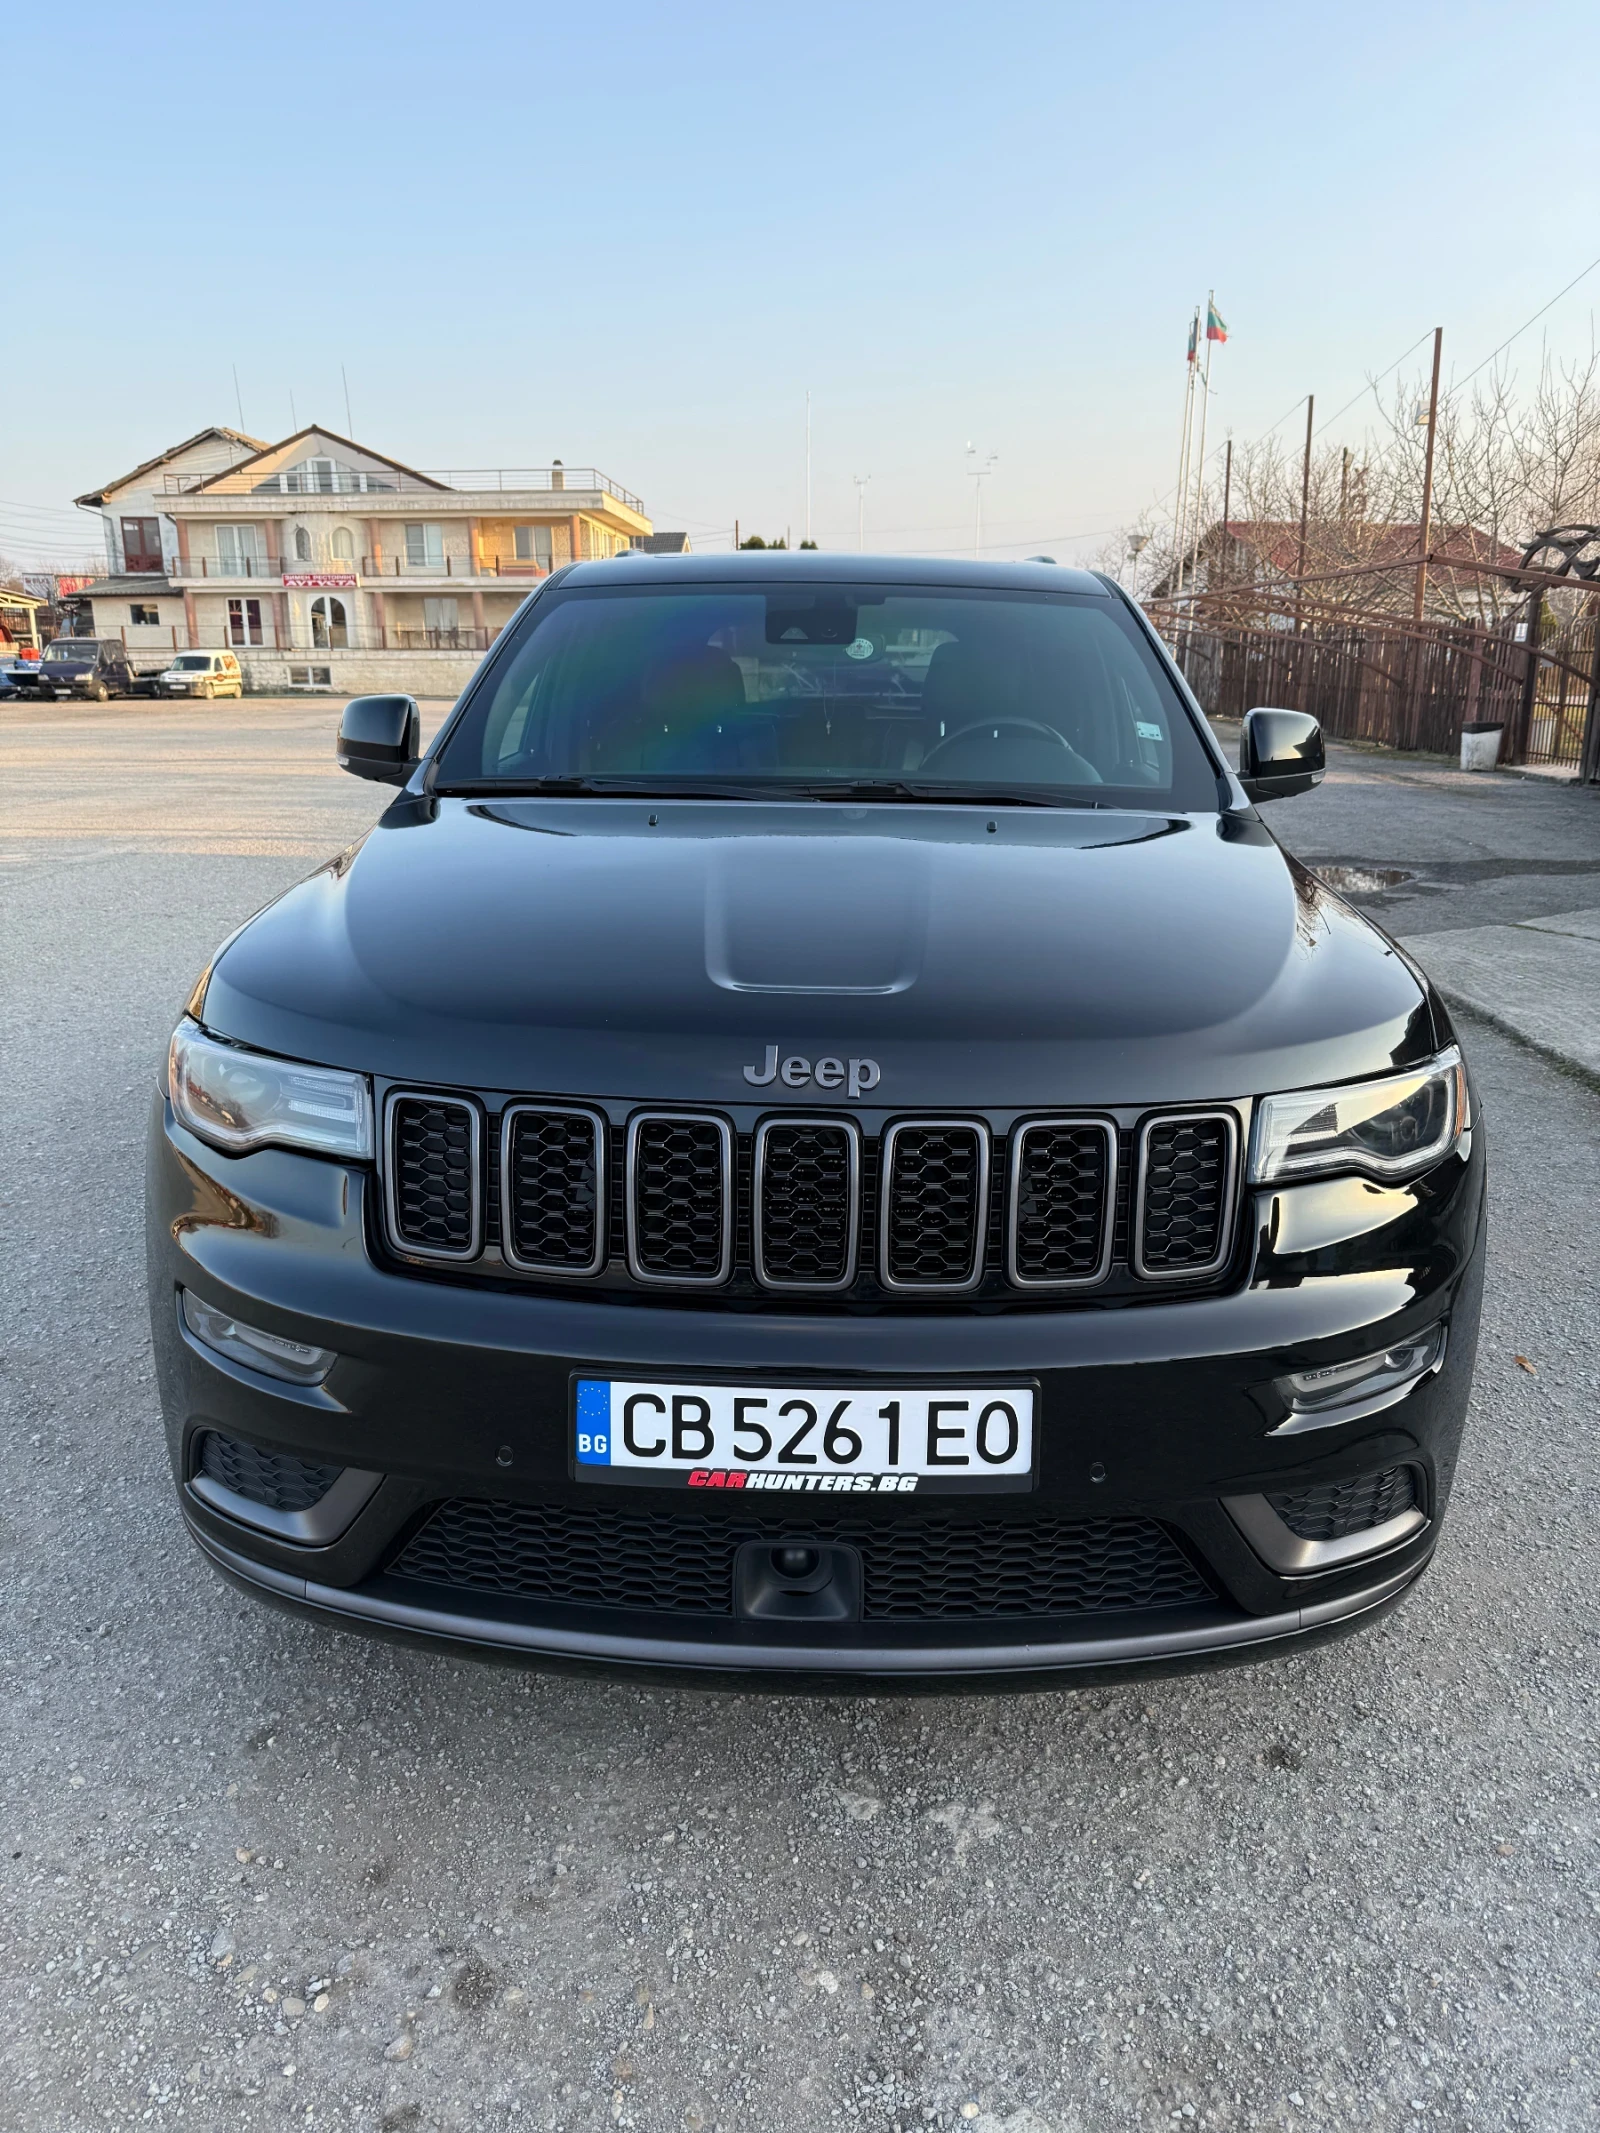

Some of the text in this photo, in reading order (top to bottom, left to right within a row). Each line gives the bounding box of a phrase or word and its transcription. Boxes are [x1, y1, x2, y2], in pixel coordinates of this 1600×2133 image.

[743, 1045, 881, 1099] Jeep
[578, 1433, 608, 1454] BG
[623, 1393, 715, 1460] CB
[733, 1398, 900, 1465] 5261
[687, 1470, 919, 1493] CARHUNTERS.BG
